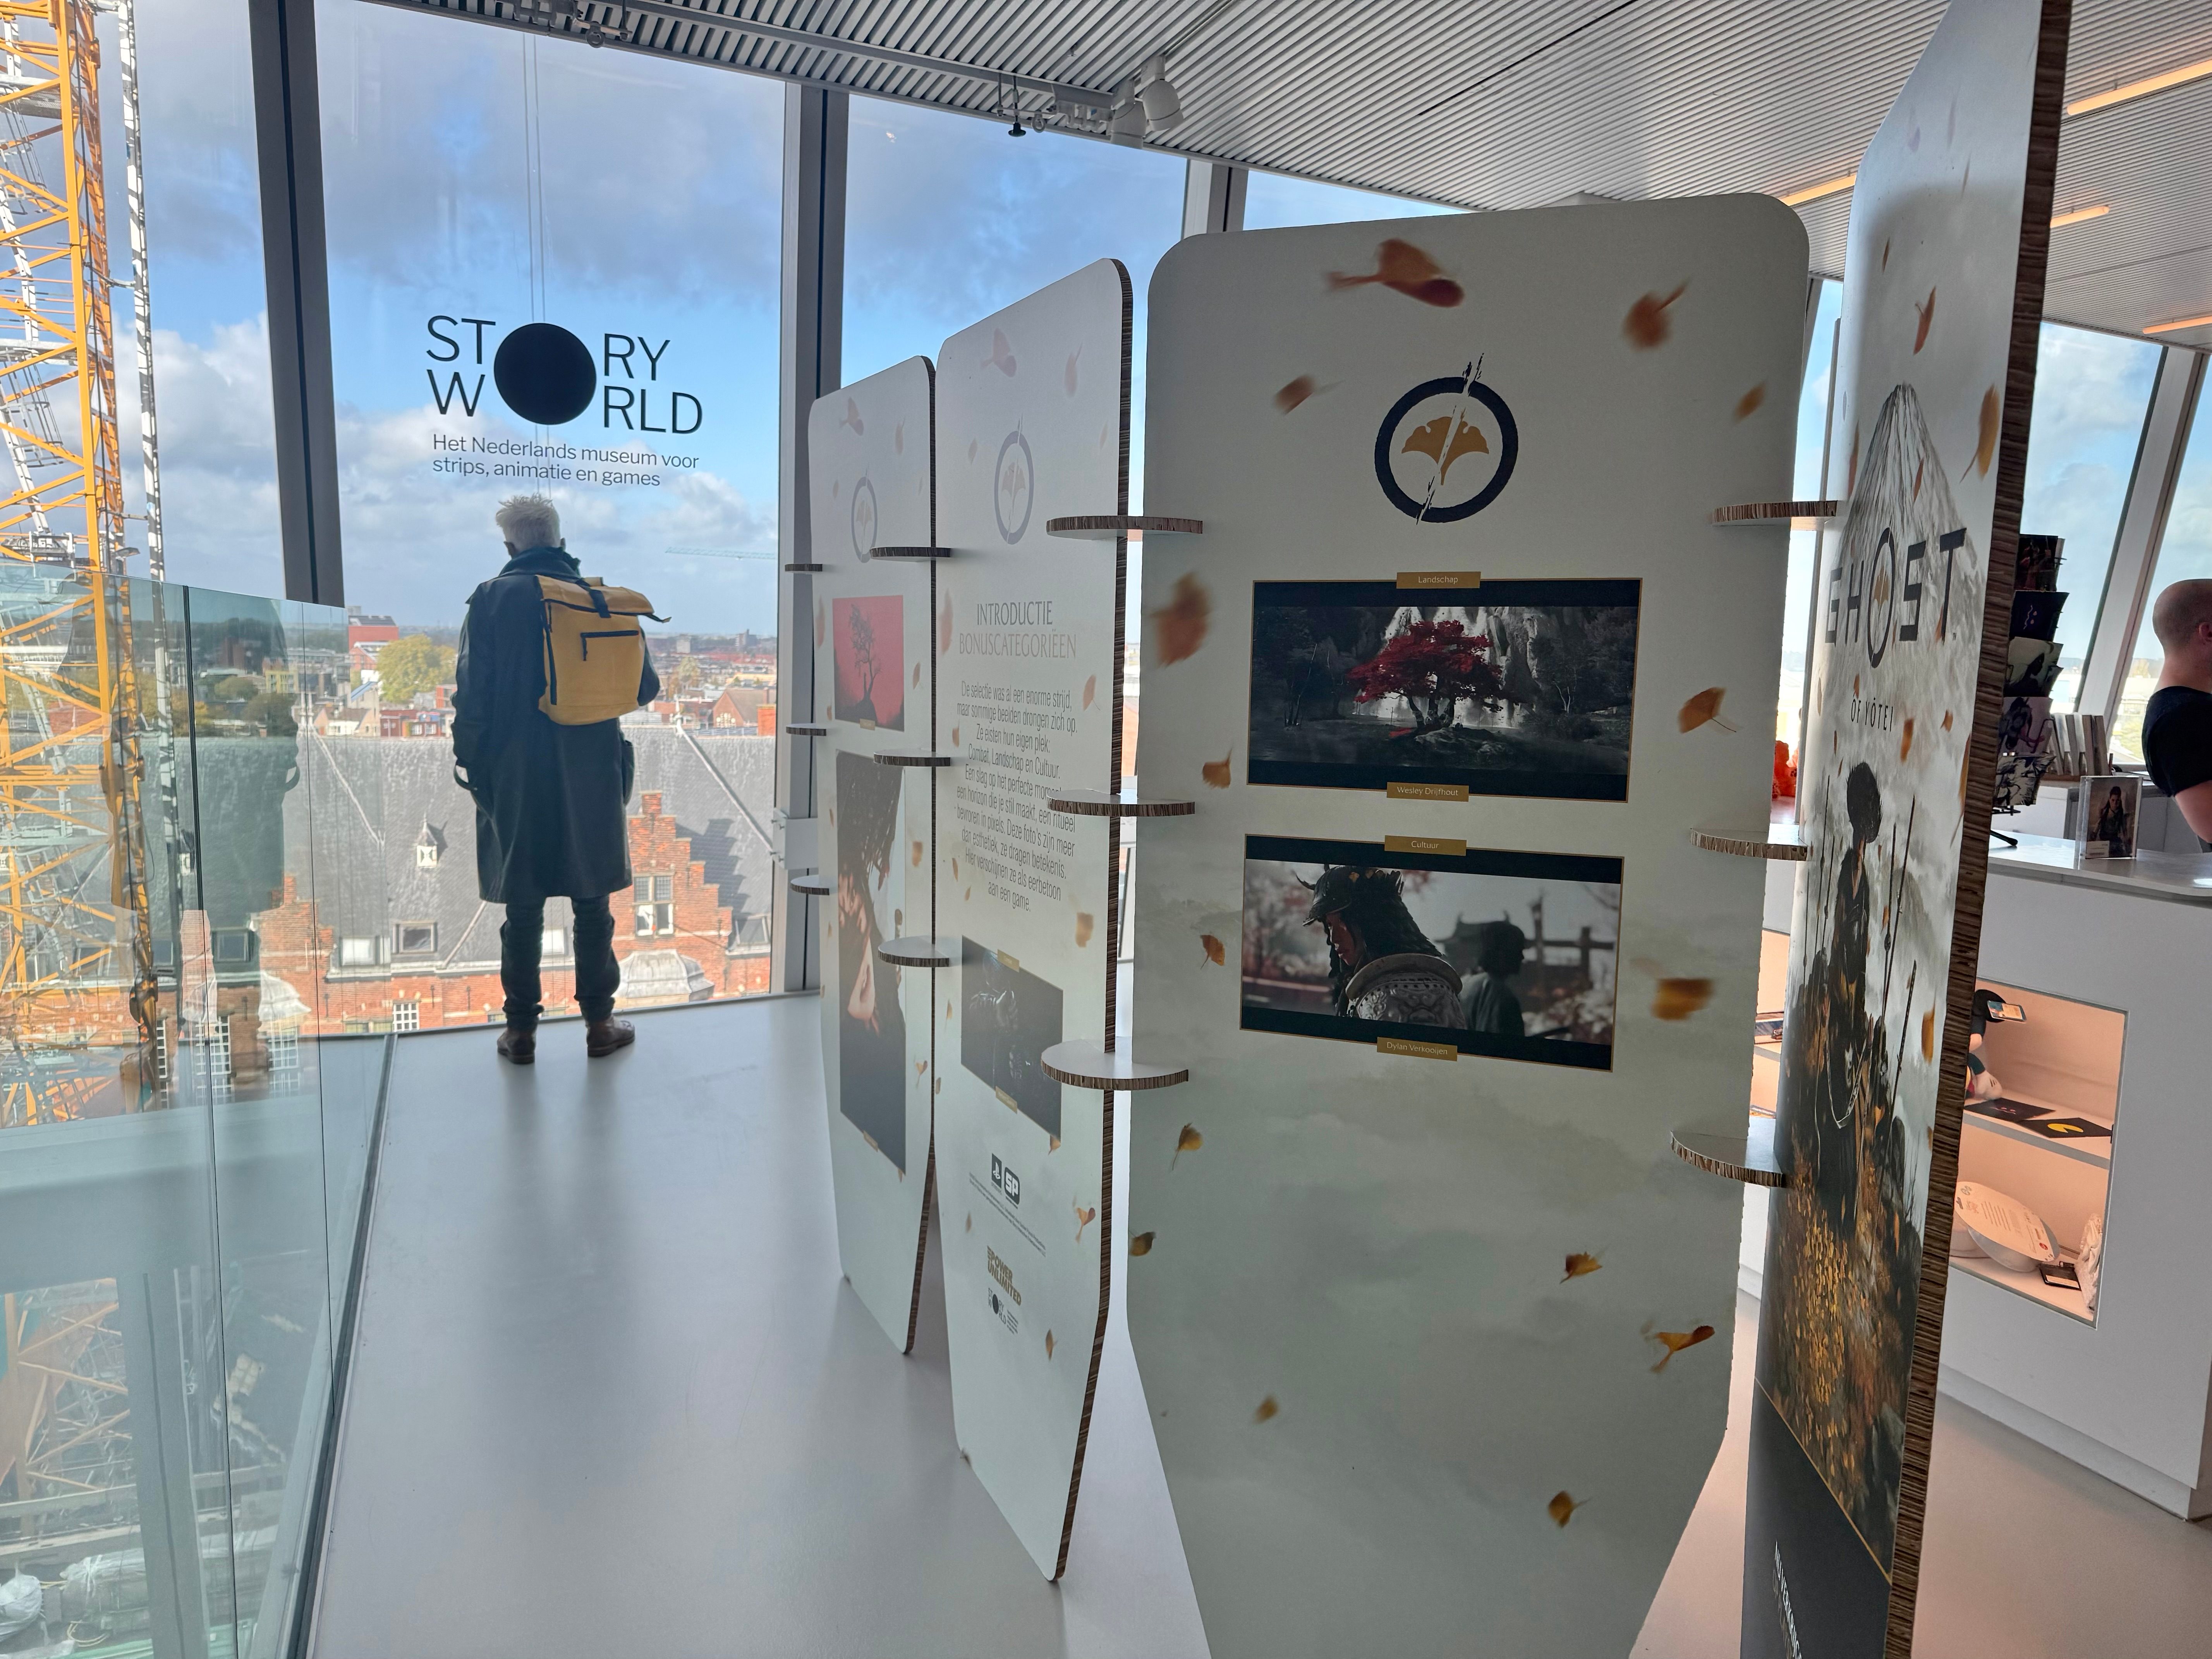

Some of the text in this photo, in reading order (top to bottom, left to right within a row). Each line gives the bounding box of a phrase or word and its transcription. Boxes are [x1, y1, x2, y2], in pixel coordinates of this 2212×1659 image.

[433, 434, 699, 469] Het Nederlands museum voor
[433, 457, 660, 486] strips, animatie en games
[977, 601, 1053, 625] INTRODUCTIE
[1825, 527, 1966, 668] GHOST
[960, 629, 1076, 658] BONUSCATEGORIËEN
[962, 681, 1072, 712] De selectie was al een enorme strijd,
[957, 702, 1077, 737] maar sommige beelden drongen zich op.
[977, 723, 1050, 754] Ze eisten hun eigen plek:
[969, 743, 1060, 779] Combat, Landschap en Cultuur.
[965, 764, 975, 781] Een
[976, 767, 988, 788] slag
[989, 773, 996, 790] op
[998, 772, 1006, 790] het
[1008, 776, 1033, 797] perfecte
[1397, 787, 1458, 796] Wesley Drijfhout
[957, 785, 1075, 833] een horizon die je stil maakt, een ritueel
[957, 804, 1075, 857] bevroren in pixels. Deze foto's zijn meer
[962, 827, 971, 843] dan
[973, 832, 999, 857] esthetiek,
[1001, 842, 1007, 857] ze
[1009, 843, 1030, 866] dragen
[965, 847, 1061, 901] Hier verschijnen ze als eerbetoon
[988, 881, 1030, 912] aan een game.
[1387, 1042, 1407, 1051] Dylan
[988, 1245, 1012, 1284] POWER
[988, 1259, 1022, 1306] UNLIMITED
